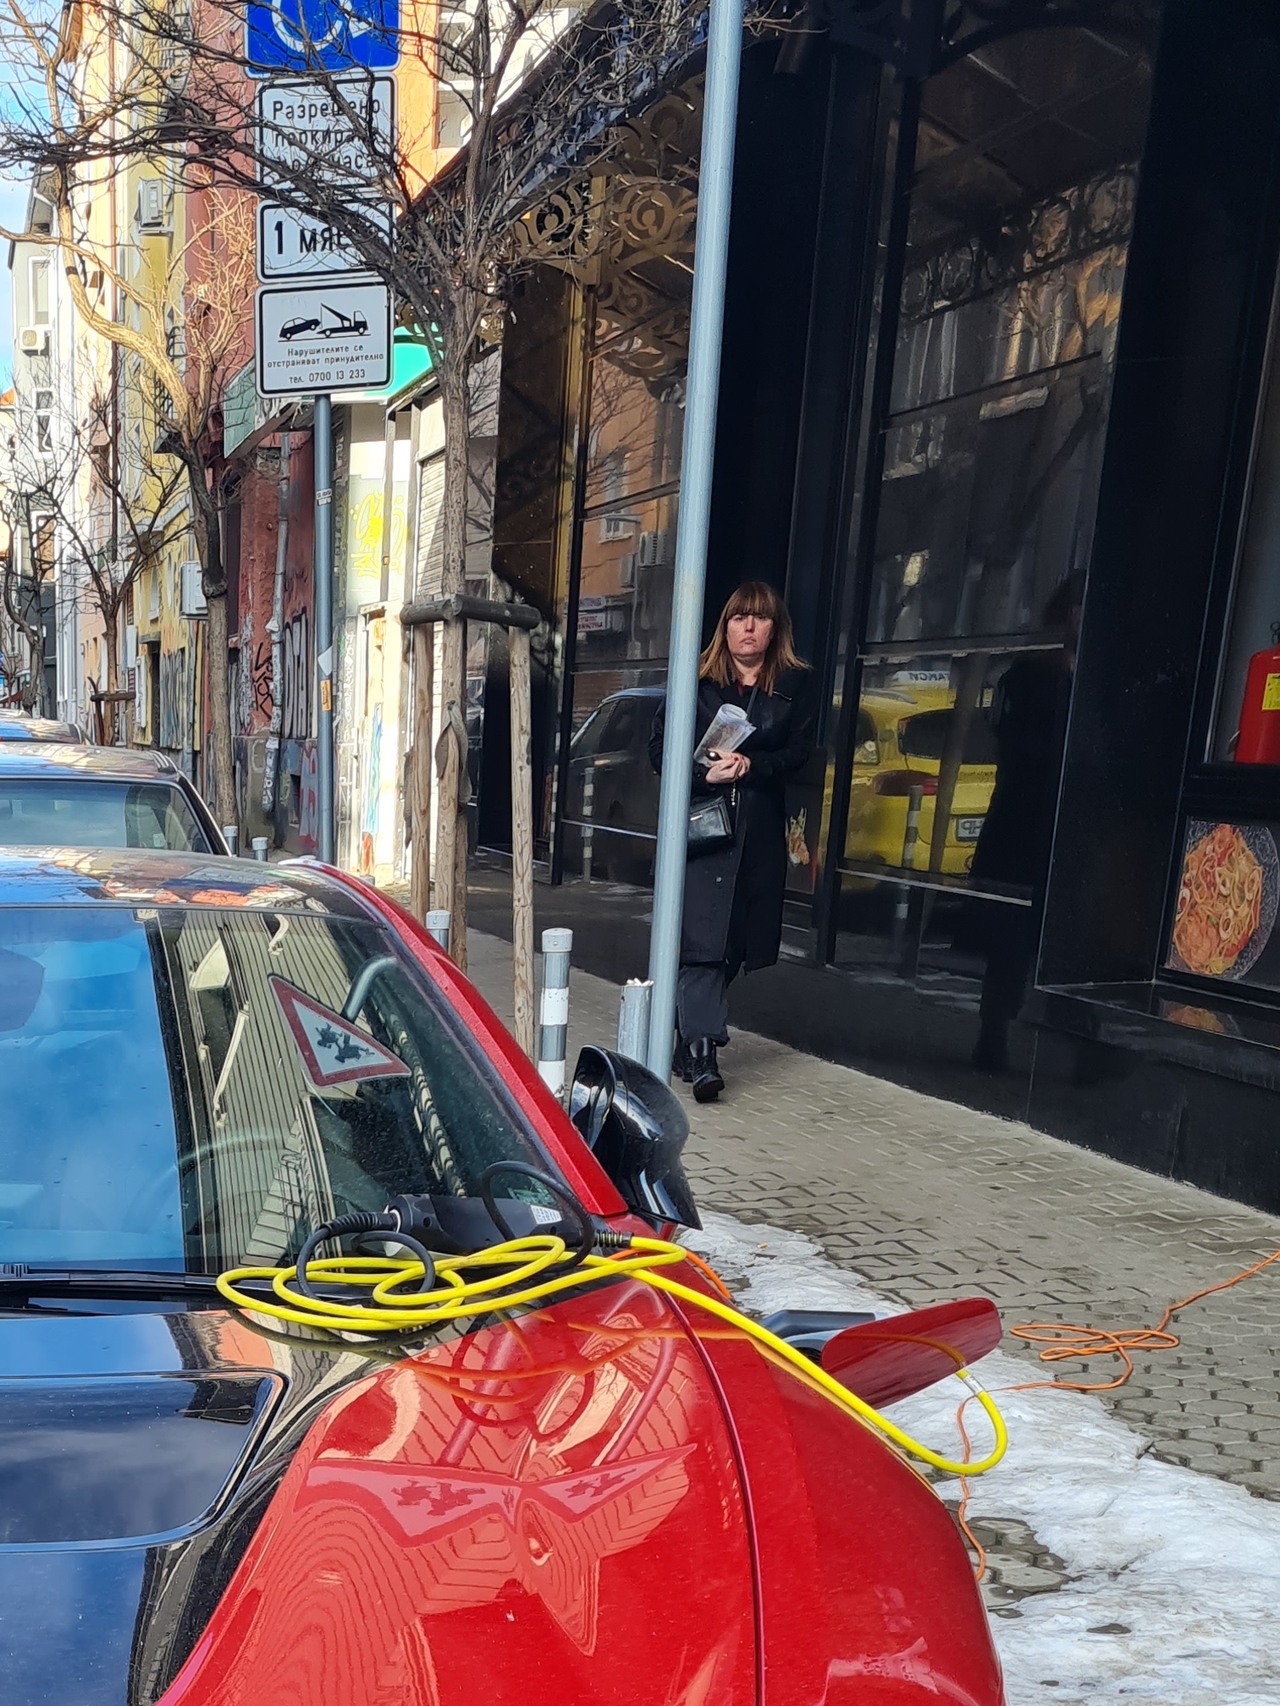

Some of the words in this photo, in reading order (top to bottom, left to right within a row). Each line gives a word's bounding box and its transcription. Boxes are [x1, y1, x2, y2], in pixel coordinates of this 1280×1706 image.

[274, 220, 283, 255] 1
[299, 227, 362, 253] мяс
[288, 346, 349, 357] Нарушителите
[267, 358, 320, 368] отстраняват
[324, 353, 384, 365] принудително
[289, 376, 304, 384] тел.
[309, 371, 331, 382] 0700
[336, 371, 344, 380] 13
[349, 369, 366, 379] 233
